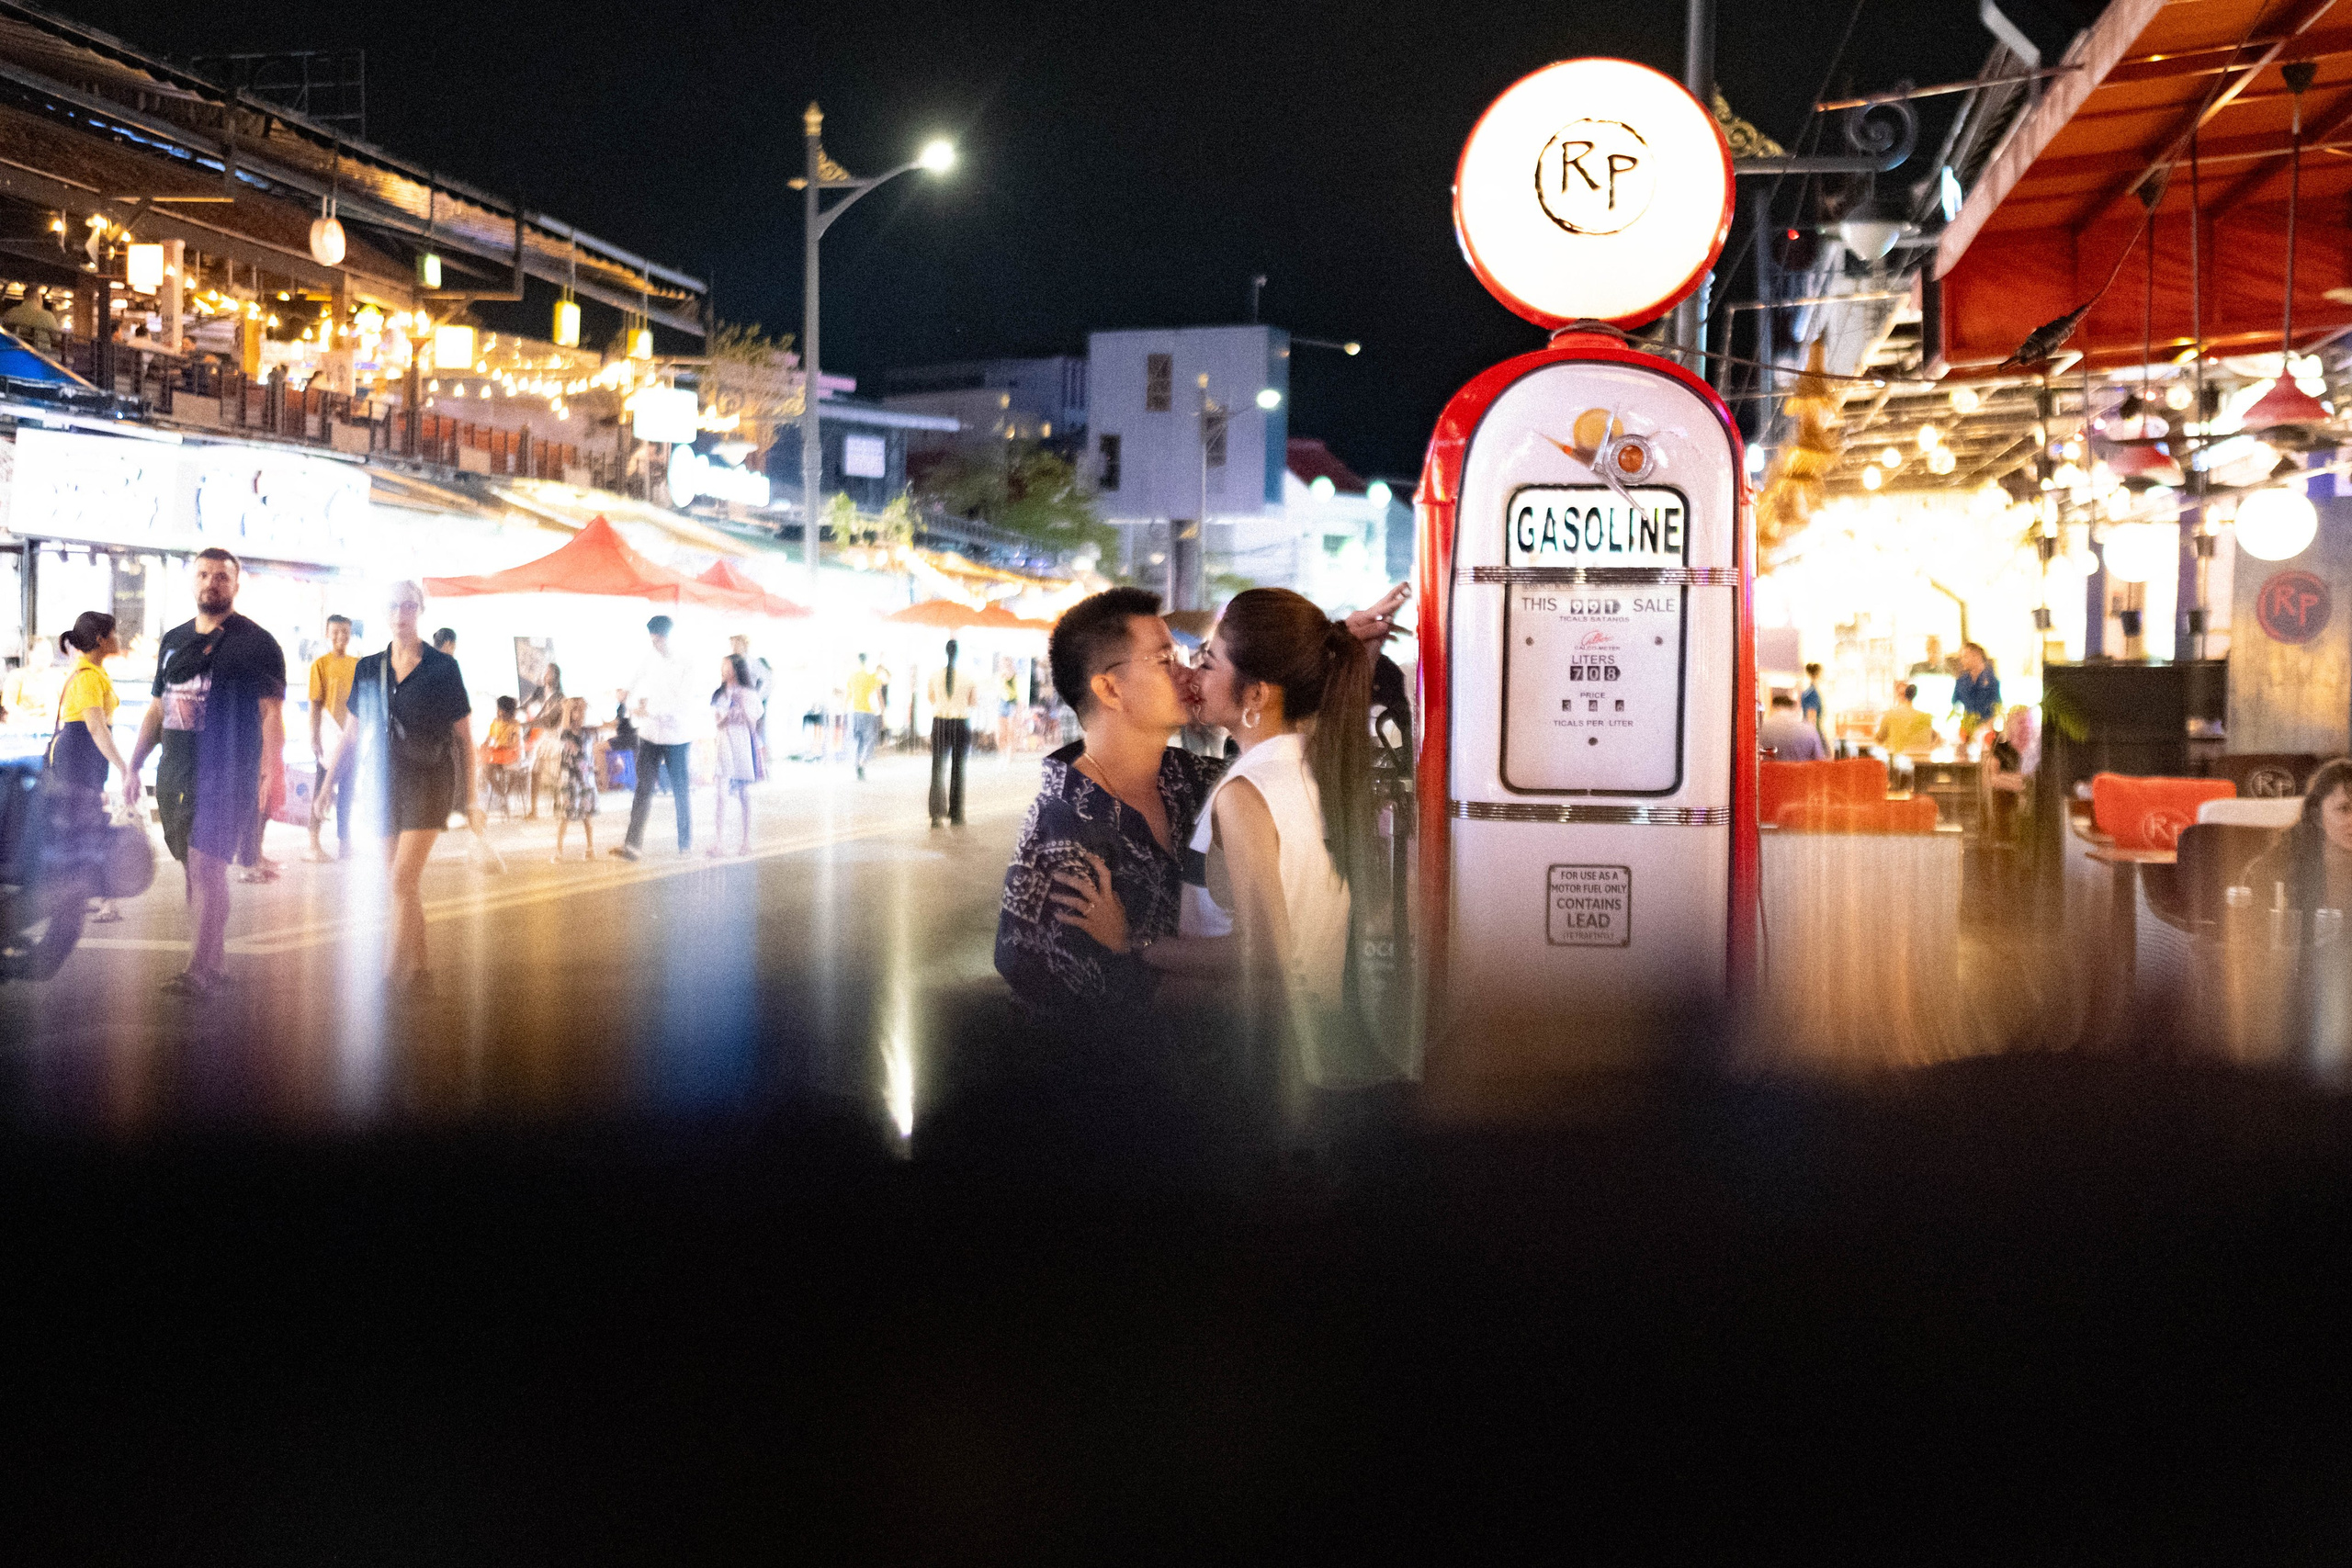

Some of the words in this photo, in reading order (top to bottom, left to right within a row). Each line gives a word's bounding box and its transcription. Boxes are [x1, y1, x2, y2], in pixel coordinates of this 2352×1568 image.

[1562, 142, 1638, 210] RP
[1517, 506, 1681, 554] GASOLINE
[1522, 598, 1557, 612] THIS
[1633, 599, 1675, 613] SALE
[2273, 584, 2319, 626] RP
[1572, 655, 1615, 664] LITERS
[1561, 871, 1577, 880] FOR
[1580, 871, 1597, 880] USE
[1599, 871, 1611, 880] AS
[1612, 871, 1619, 880] A
[1552, 885, 1581, 893] MOTOR
[1583, 885, 1602, 893] FUEL
[1604, 885, 1626, 894] ONLY
[1556, 898, 1622, 910] CONTAINS
[1566, 914, 1611, 928] LEAD
